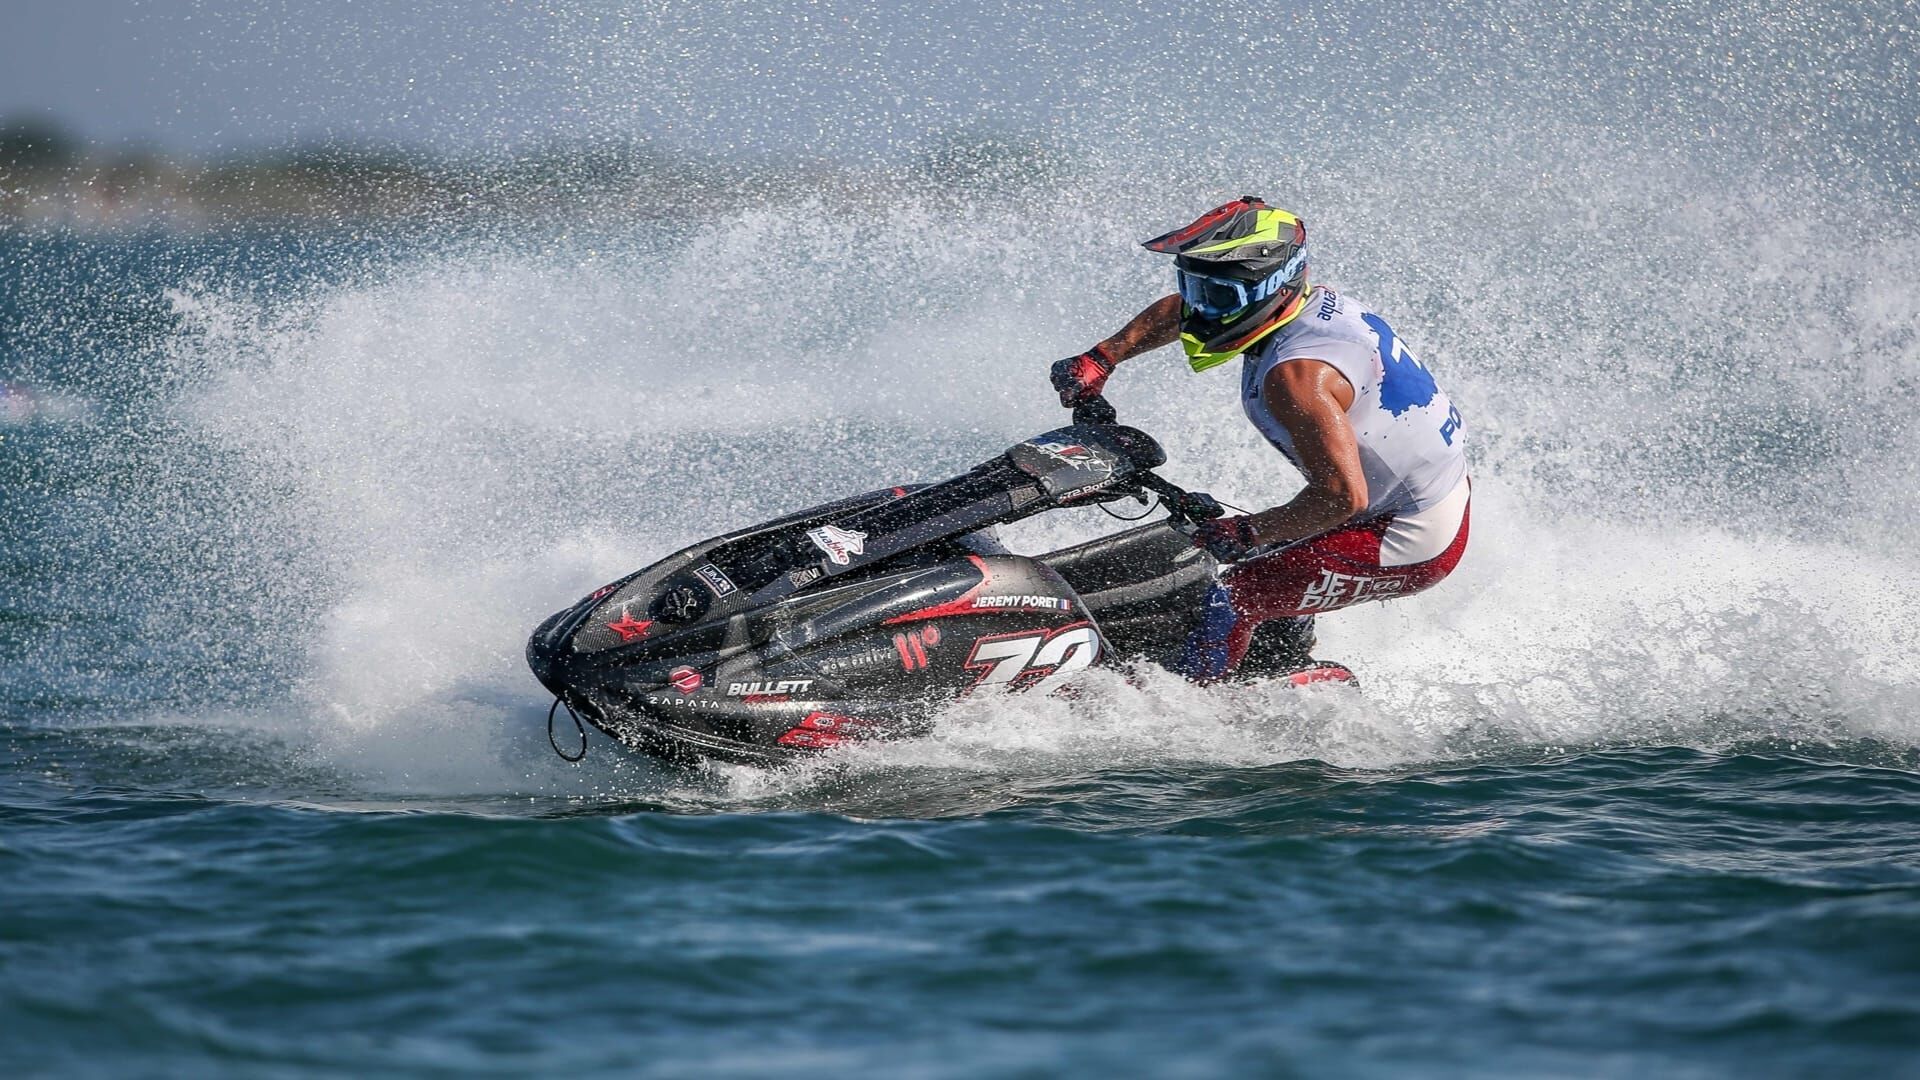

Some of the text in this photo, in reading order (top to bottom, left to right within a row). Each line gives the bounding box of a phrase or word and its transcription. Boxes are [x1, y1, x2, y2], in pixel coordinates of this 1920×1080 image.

[1303, 567, 1372, 597] JET
[972, 595, 1058, 608] JEREMY PORET
[967, 625, 1100, 692] 72
[727, 680, 813, 696] BULLETT
[650, 697, 720, 709] ZAPATA
